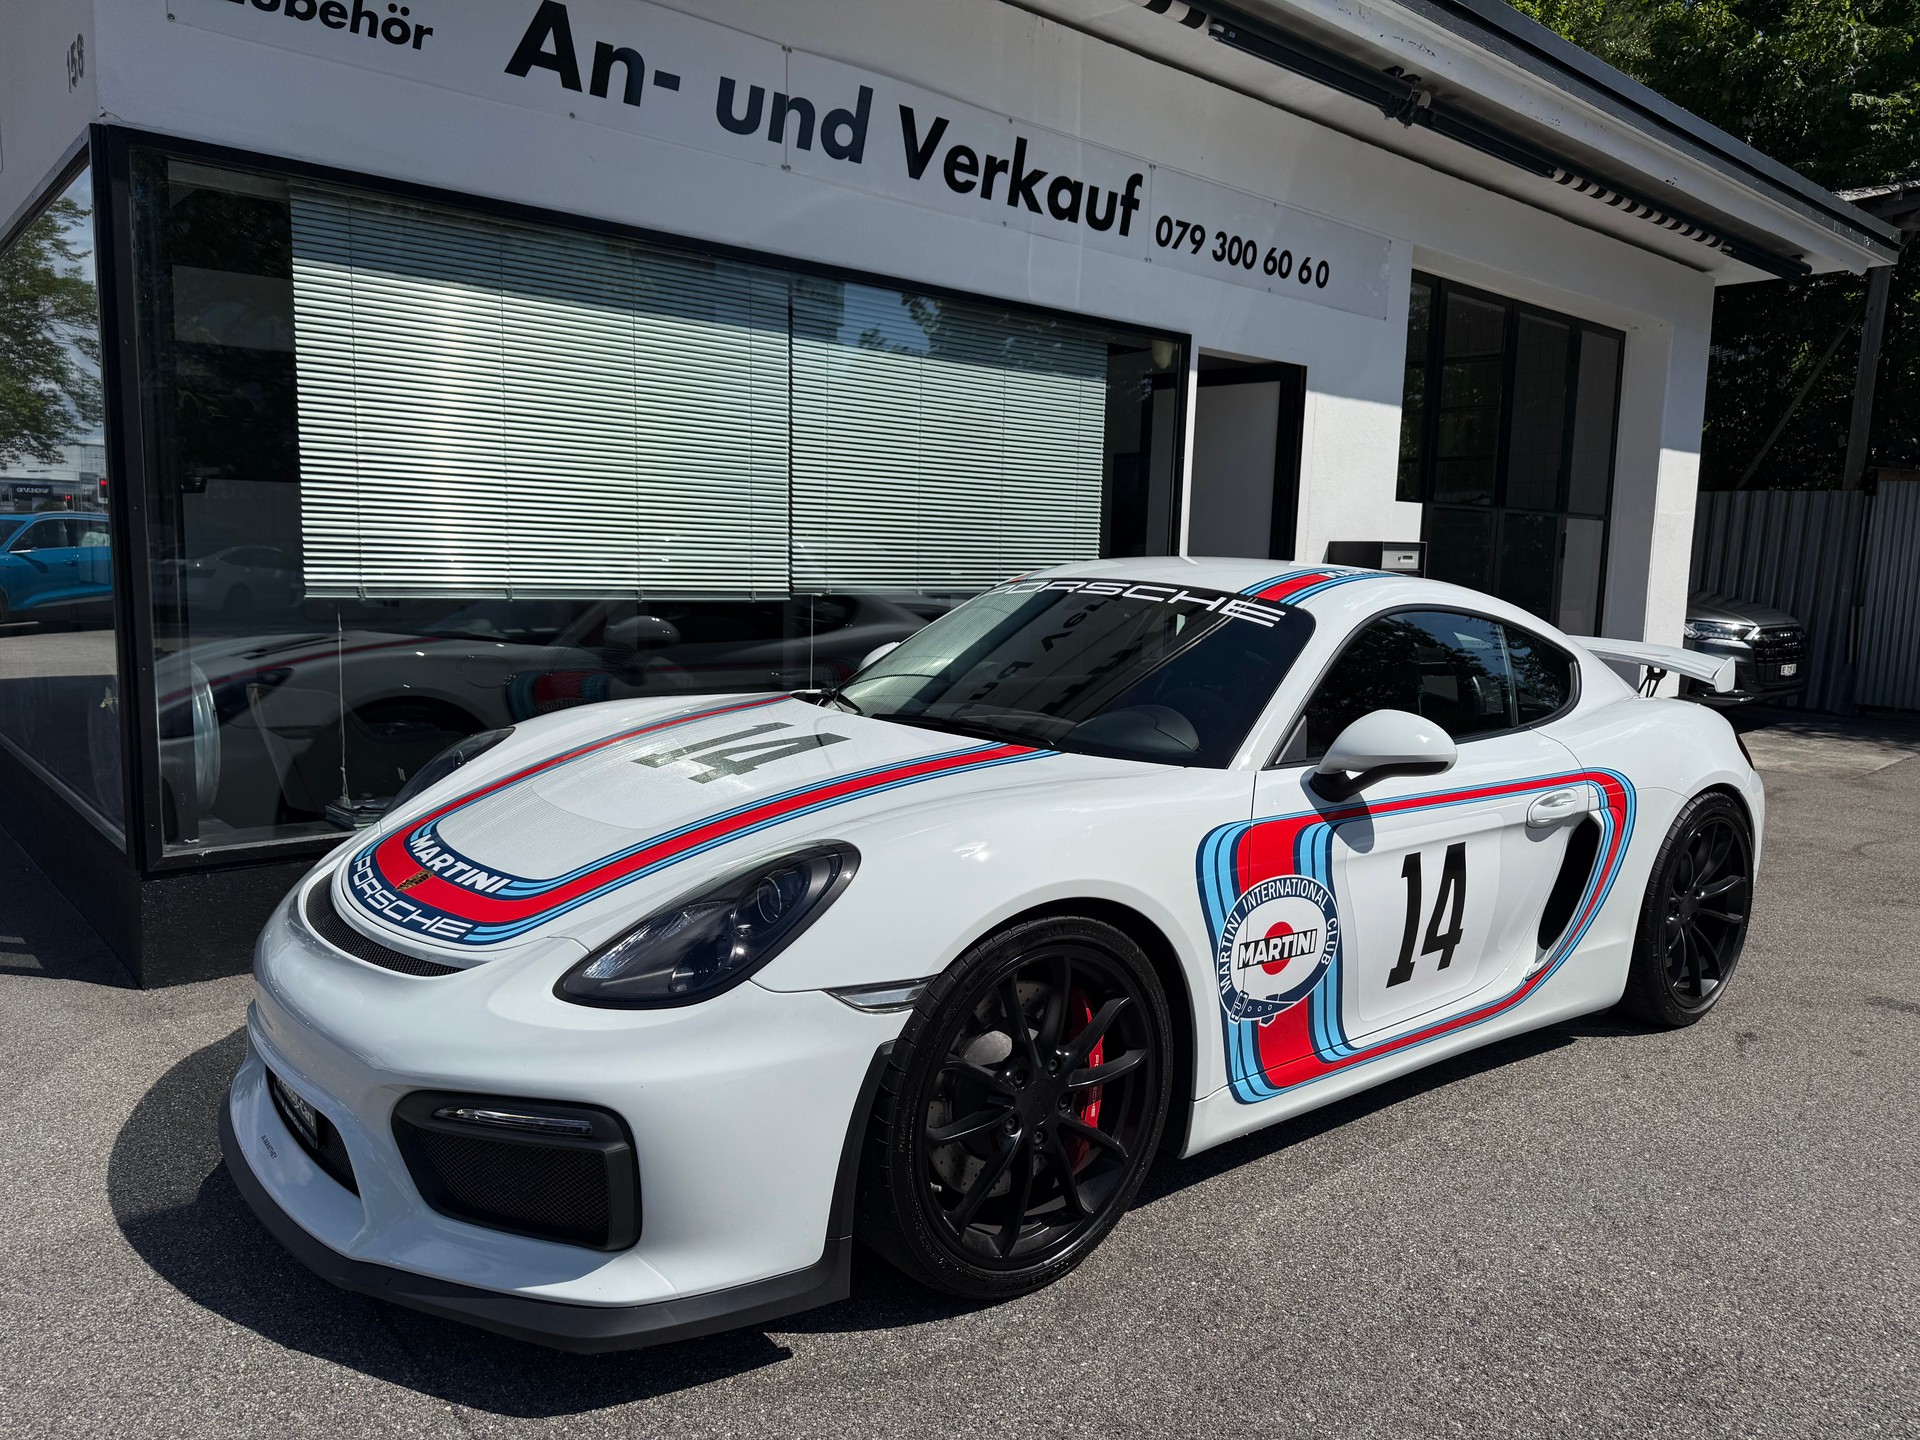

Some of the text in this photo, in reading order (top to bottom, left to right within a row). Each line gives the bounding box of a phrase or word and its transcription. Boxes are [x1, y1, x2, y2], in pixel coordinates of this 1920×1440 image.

[67, 33, 84, 94] 158
[504, 0, 1144, 238] An- und Verkauf
[1155, 214, 1329, 289] 079 300 60 60
[977, 580, 1286, 627] PORSCHE
[631, 722, 851, 784] 14
[353, 856, 473, 938] PORSCHE
[410, 834, 512, 894] MARTINI
[1220, 879, 1338, 994] MARTINI INTERNATIONAL CLUB
[1239, 930, 1316, 968] MARTINI
[1386, 842, 1466, 988] 14
